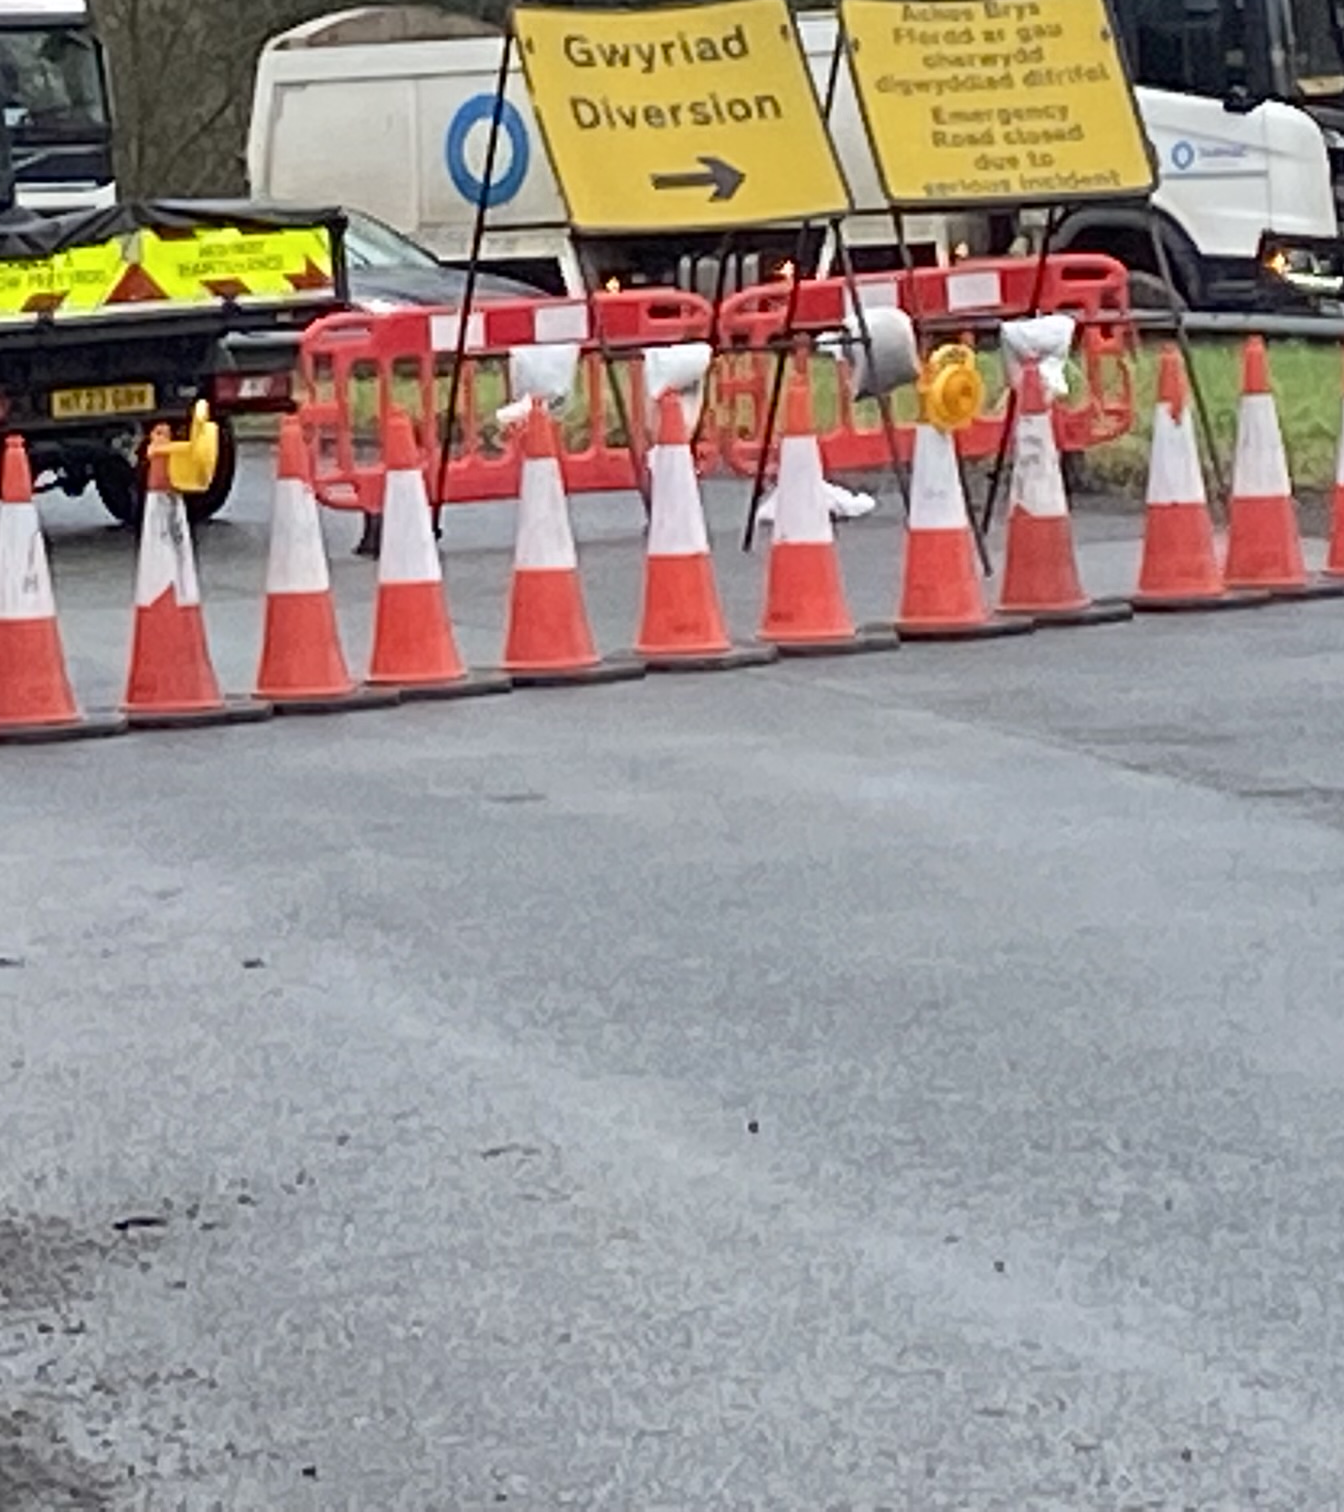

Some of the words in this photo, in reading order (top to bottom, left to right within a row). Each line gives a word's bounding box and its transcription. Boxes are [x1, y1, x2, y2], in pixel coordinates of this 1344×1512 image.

[562, 24, 749, 74] Gwyriad
[569, 92, 783, 131] Diversion
[931, 103, 1069, 126] Emergency
[932, 127, 995, 148] Road
[1003, 124, 1085, 145] closed
[974, 152, 1020, 171] due
[1027, 151, 1054, 168] to
